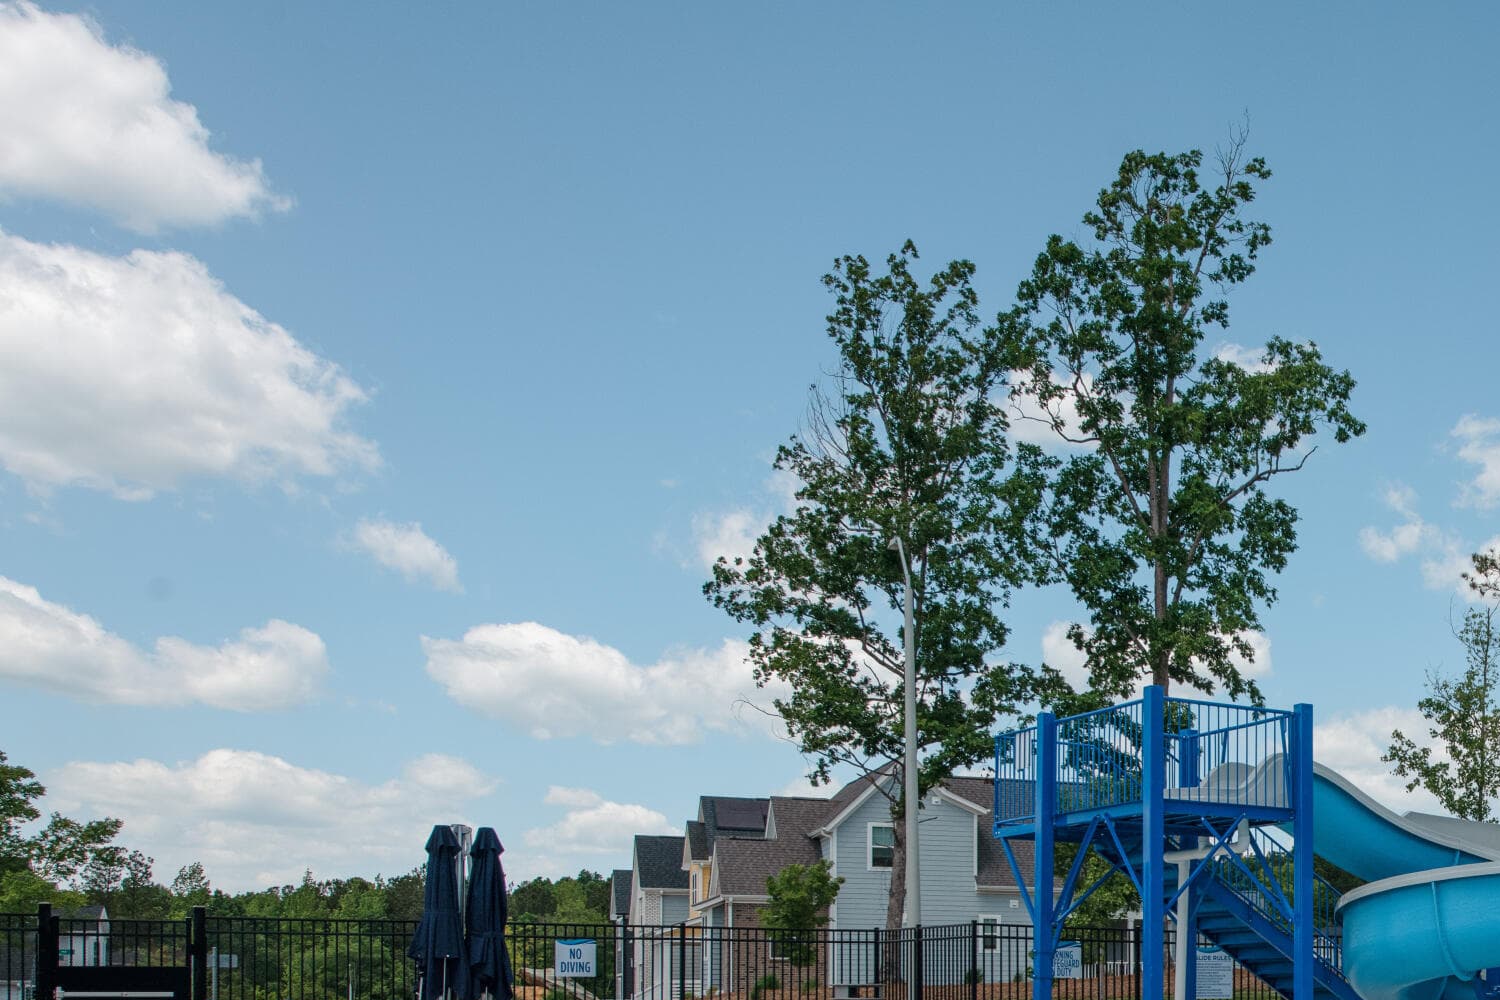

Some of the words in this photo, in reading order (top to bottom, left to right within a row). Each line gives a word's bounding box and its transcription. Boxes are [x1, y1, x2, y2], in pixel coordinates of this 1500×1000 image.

[569, 948, 582, 960] NO
[1055, 950, 1073, 959] RNING
[560, 961, 591, 973] DIVING
